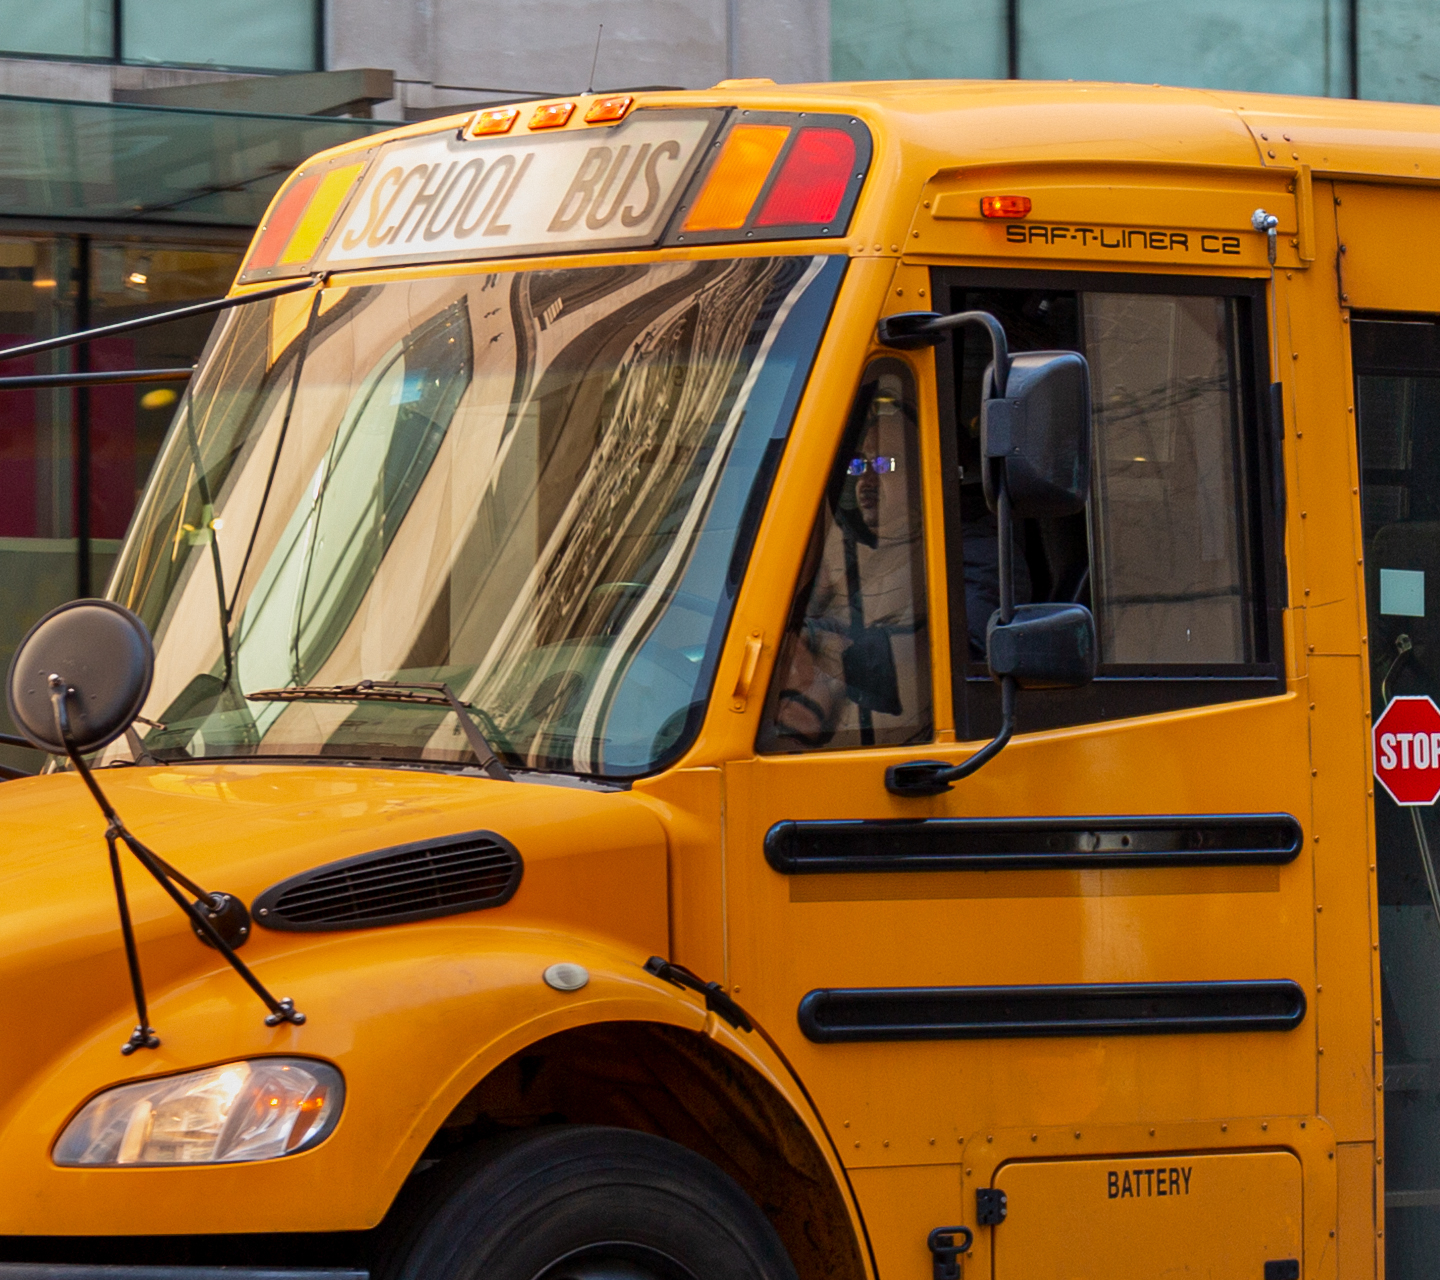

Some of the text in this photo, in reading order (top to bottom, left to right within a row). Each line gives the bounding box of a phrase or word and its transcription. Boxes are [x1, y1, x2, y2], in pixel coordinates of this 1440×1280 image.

[341, 140, 680, 251] SCHOOL BUS
[1200, 234, 1241, 255] C2
[1107, 1166, 1193, 1199] BATTERY
